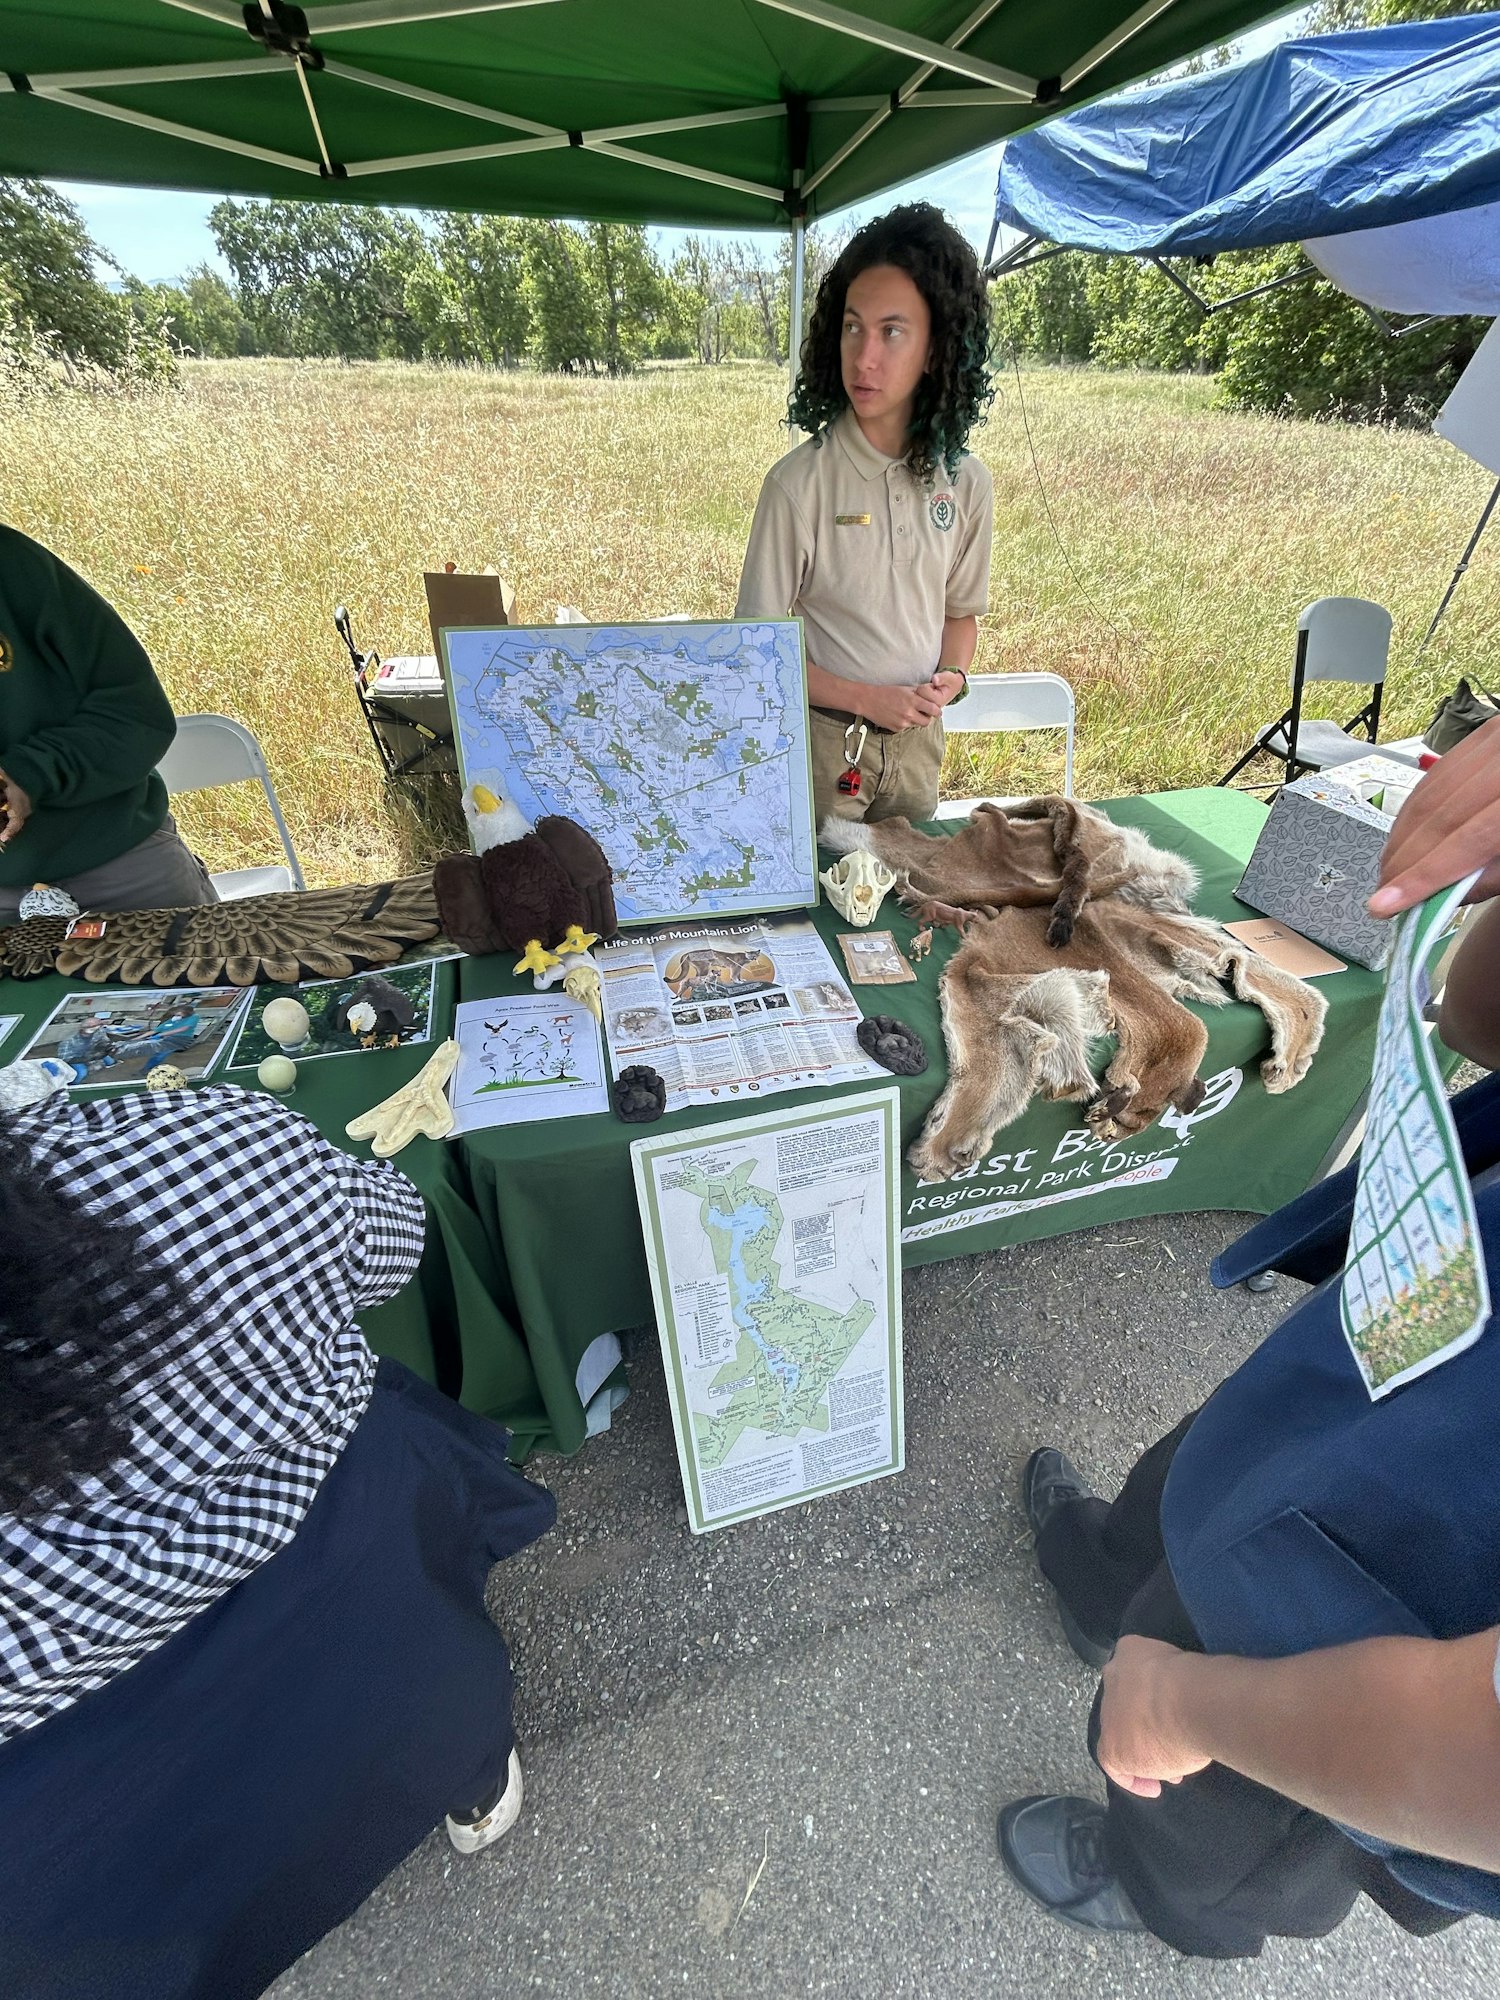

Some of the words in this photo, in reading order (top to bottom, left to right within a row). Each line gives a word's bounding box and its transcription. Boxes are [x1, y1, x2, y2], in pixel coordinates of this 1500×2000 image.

[604, 939, 628, 950] Life
[632, 936, 643, 946] of
[646, 934, 666, 945] the
[670, 928, 728, 940] Mountain
[731, 924, 758, 936] Lion
[614, 1041, 640, 1050] Mountain
[904, 1212, 980, 1240] Healthy
[1102, 1164, 1163, 1187] eople
[907, 1179, 1031, 1215] Regional
[1035, 1160, 1094, 1189] Park
